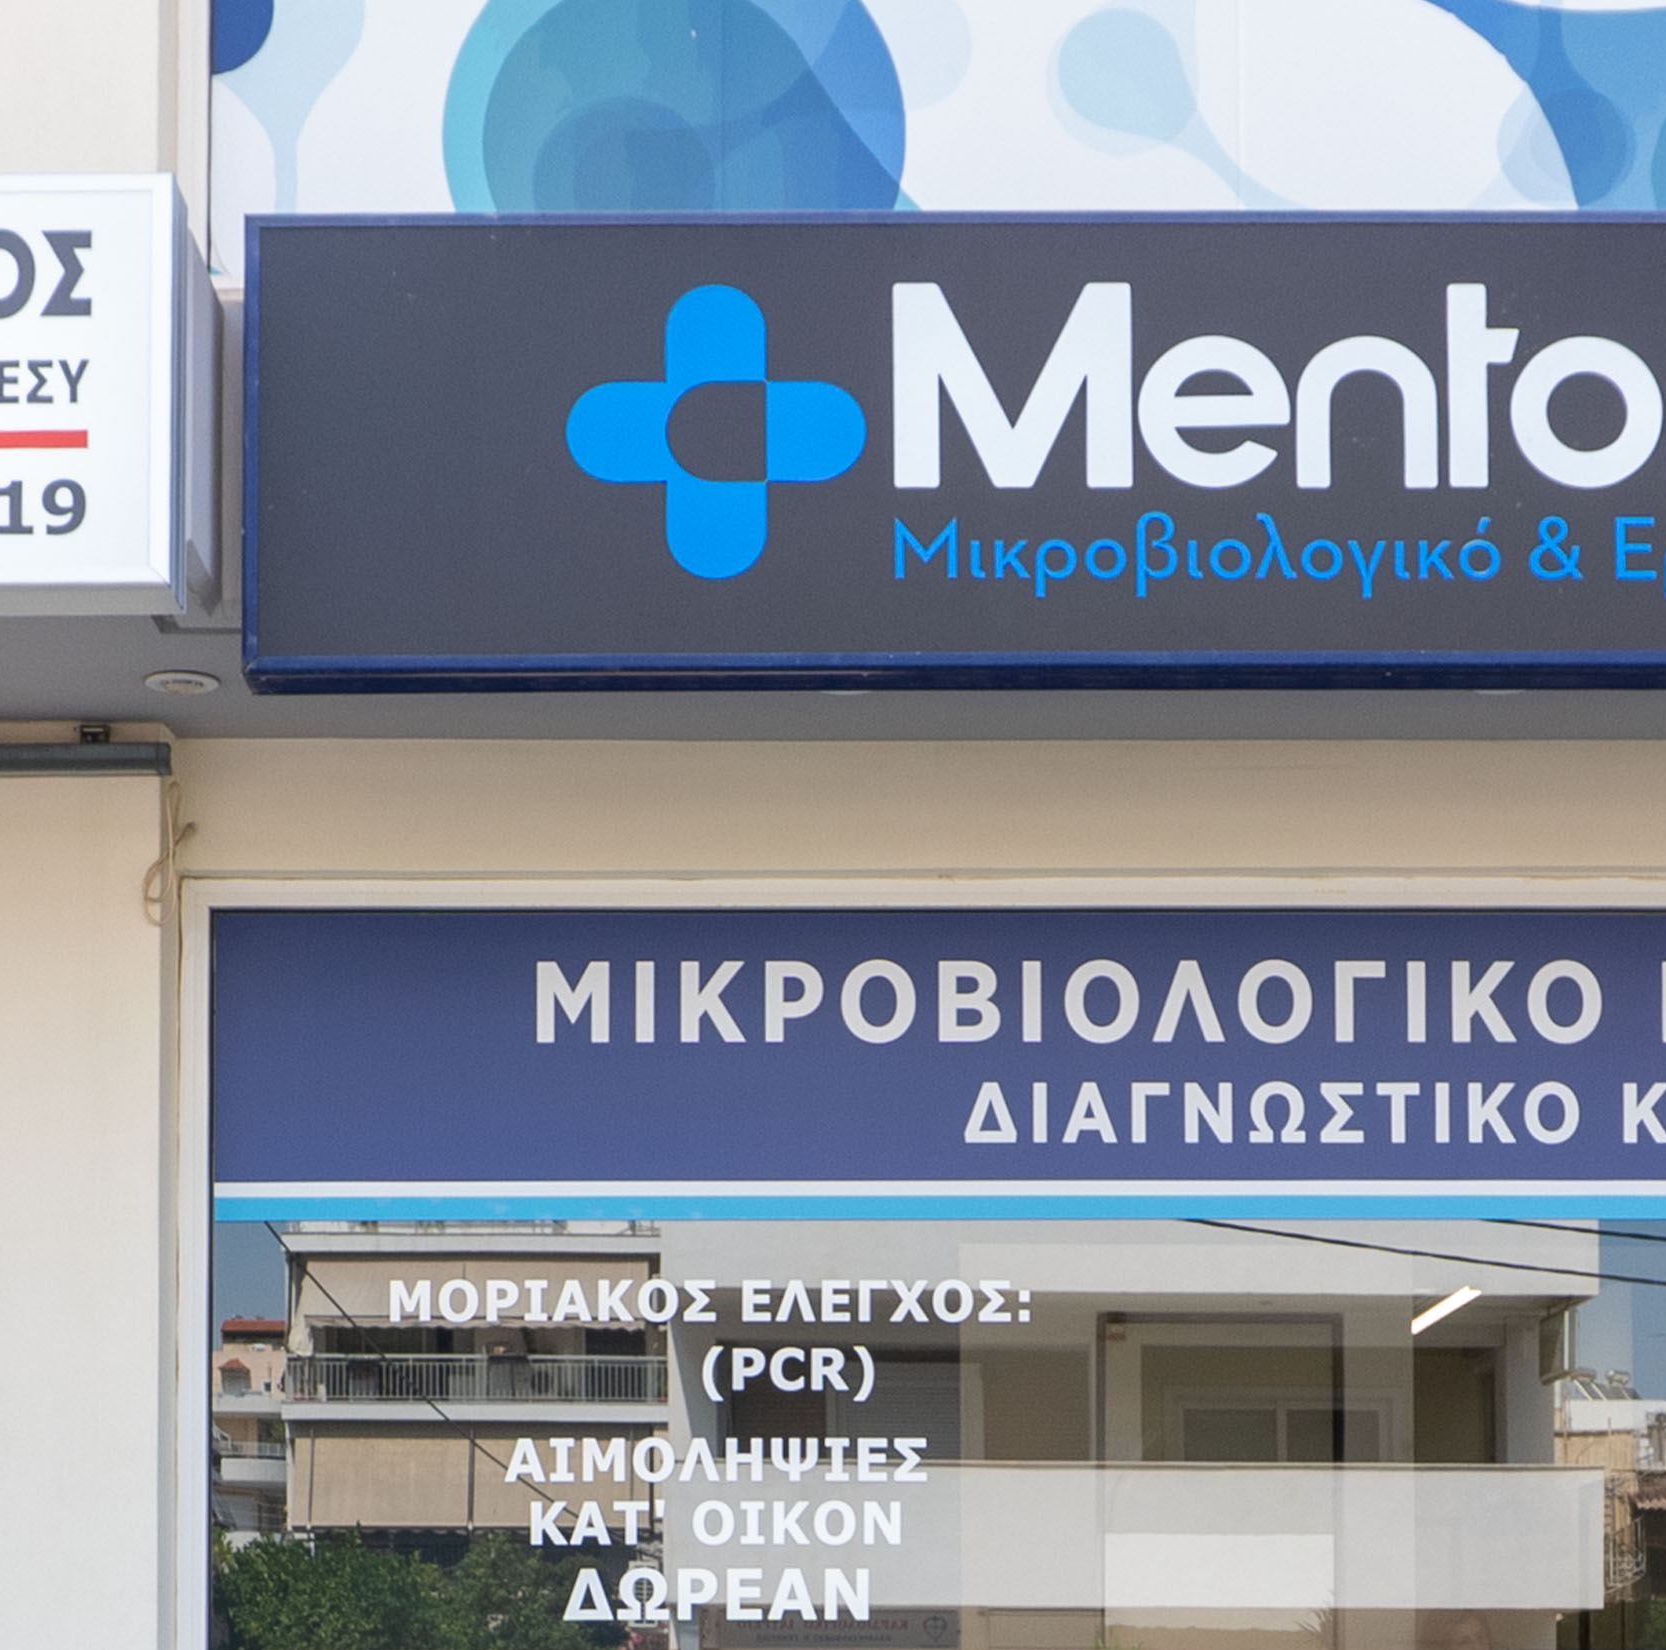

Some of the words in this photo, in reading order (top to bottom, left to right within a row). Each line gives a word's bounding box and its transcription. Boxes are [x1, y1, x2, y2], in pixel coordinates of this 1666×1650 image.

[892, 510, 1502, 600] Μικροβιολογικό
[1529, 514, 1582, 582] &
[535, 958, 1604, 1046] ΜΙΚΡΟΒΙΟΛΟΓΙΚΟ
[963, 1080, 1582, 1145] ΔΙΑΓΝΩΣΤΙΚΟ
[388, 1278, 718, 1324] ΜΟΡΙΑΚΟΣ
[740, 1278, 1032, 1324] ΕΛΕΓΧΟΣ:
[701, 1345, 877, 1402] (PCR)
[504, 1437, 929, 1484] ΑΙΜΟΛΗΨΙΕΣ
[529, 1499, 666, 1547] ΚΑΤ'
[691, 1499, 902, 1546] ΟΙΚΟΝ
[562, 1567, 870, 1622] ΔΩΡΕΑΝ
